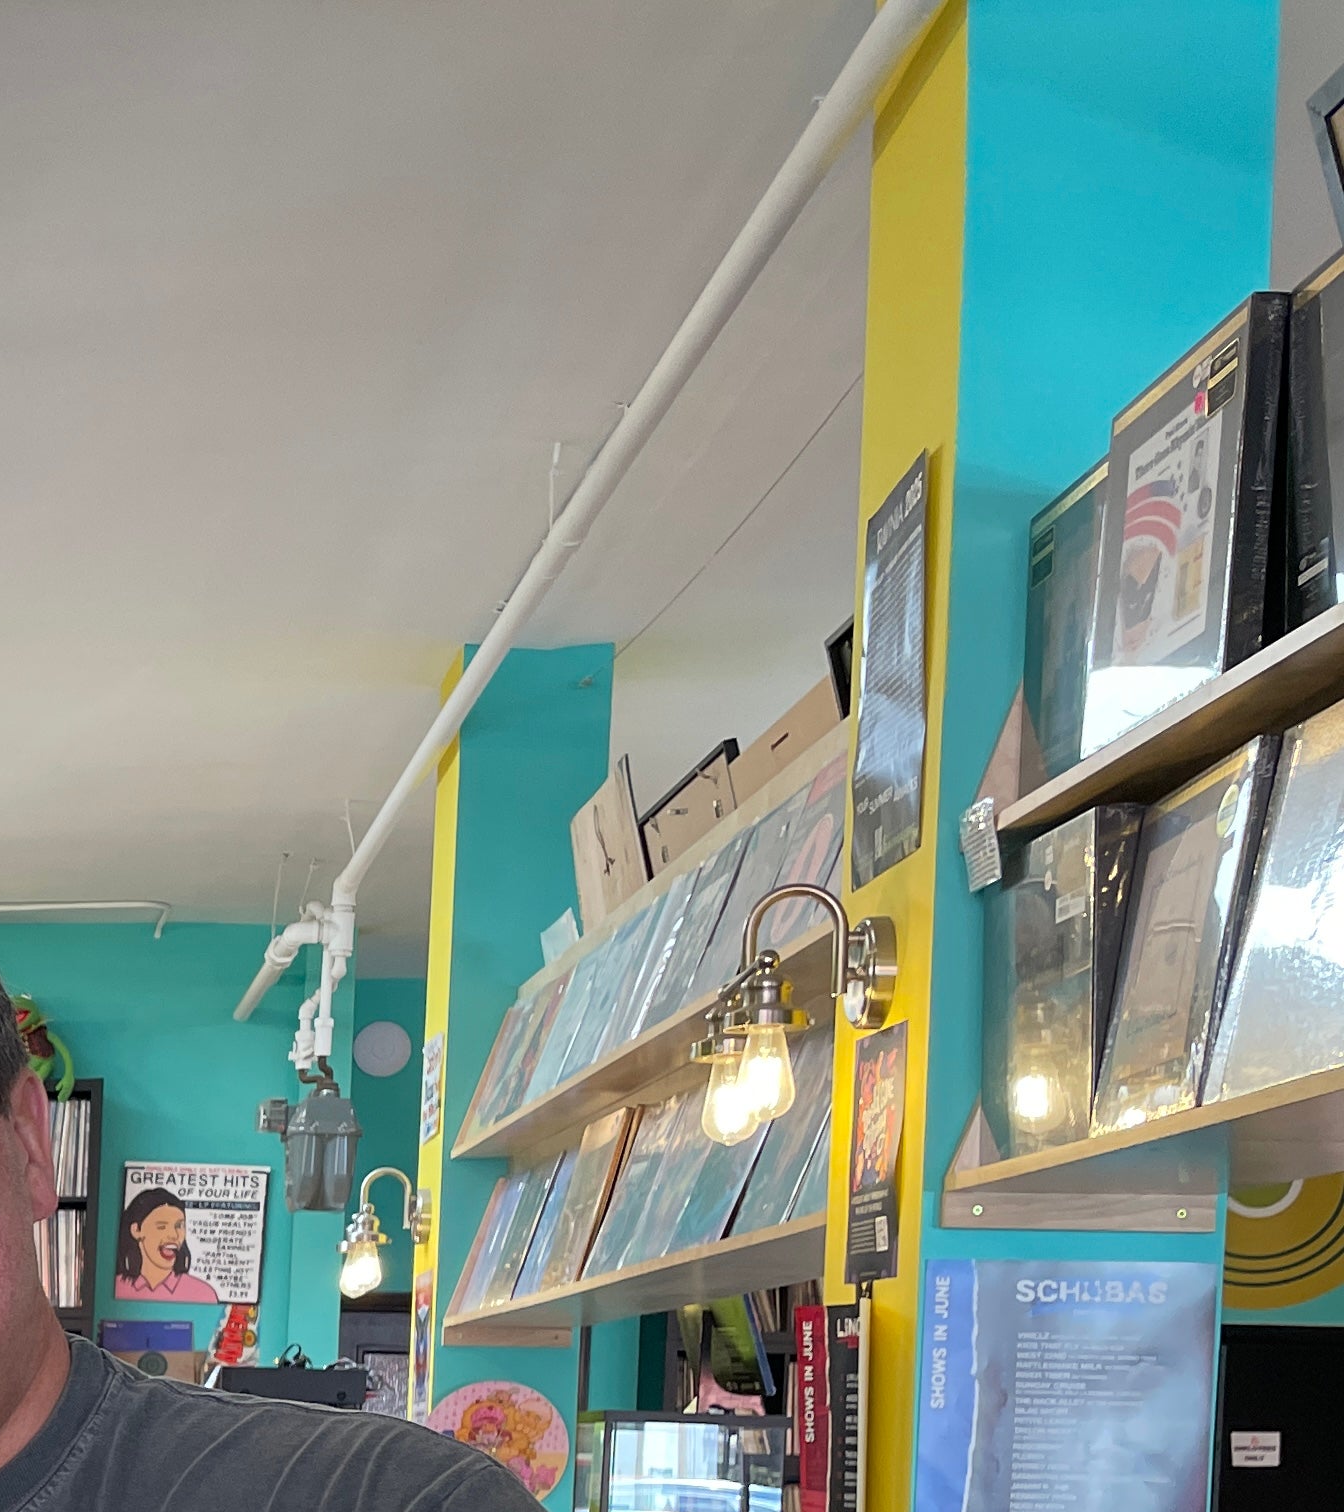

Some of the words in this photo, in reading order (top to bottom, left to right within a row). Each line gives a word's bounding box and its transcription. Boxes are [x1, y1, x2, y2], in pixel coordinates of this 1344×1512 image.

[130, 1171, 220, 1188] GREATEST
[223, 1174, 260, 1189] HITS
[178, 1187, 194, 1197] OF
[198, 1187, 231, 1199] YOUR
[233, 1190, 259, 1200] LIFE
[934, 1275, 951, 1319] JUNE
[1015, 1278, 1168, 1305] SCHUBAS
[802, 1320, 813, 1361] JUNE
[934, 1324, 948, 1341] IN
[803, 1365, 814, 1382] IN
[930, 1346, 947, 1410] SHOWS
[803, 1386, 815, 1444] SHOWS
